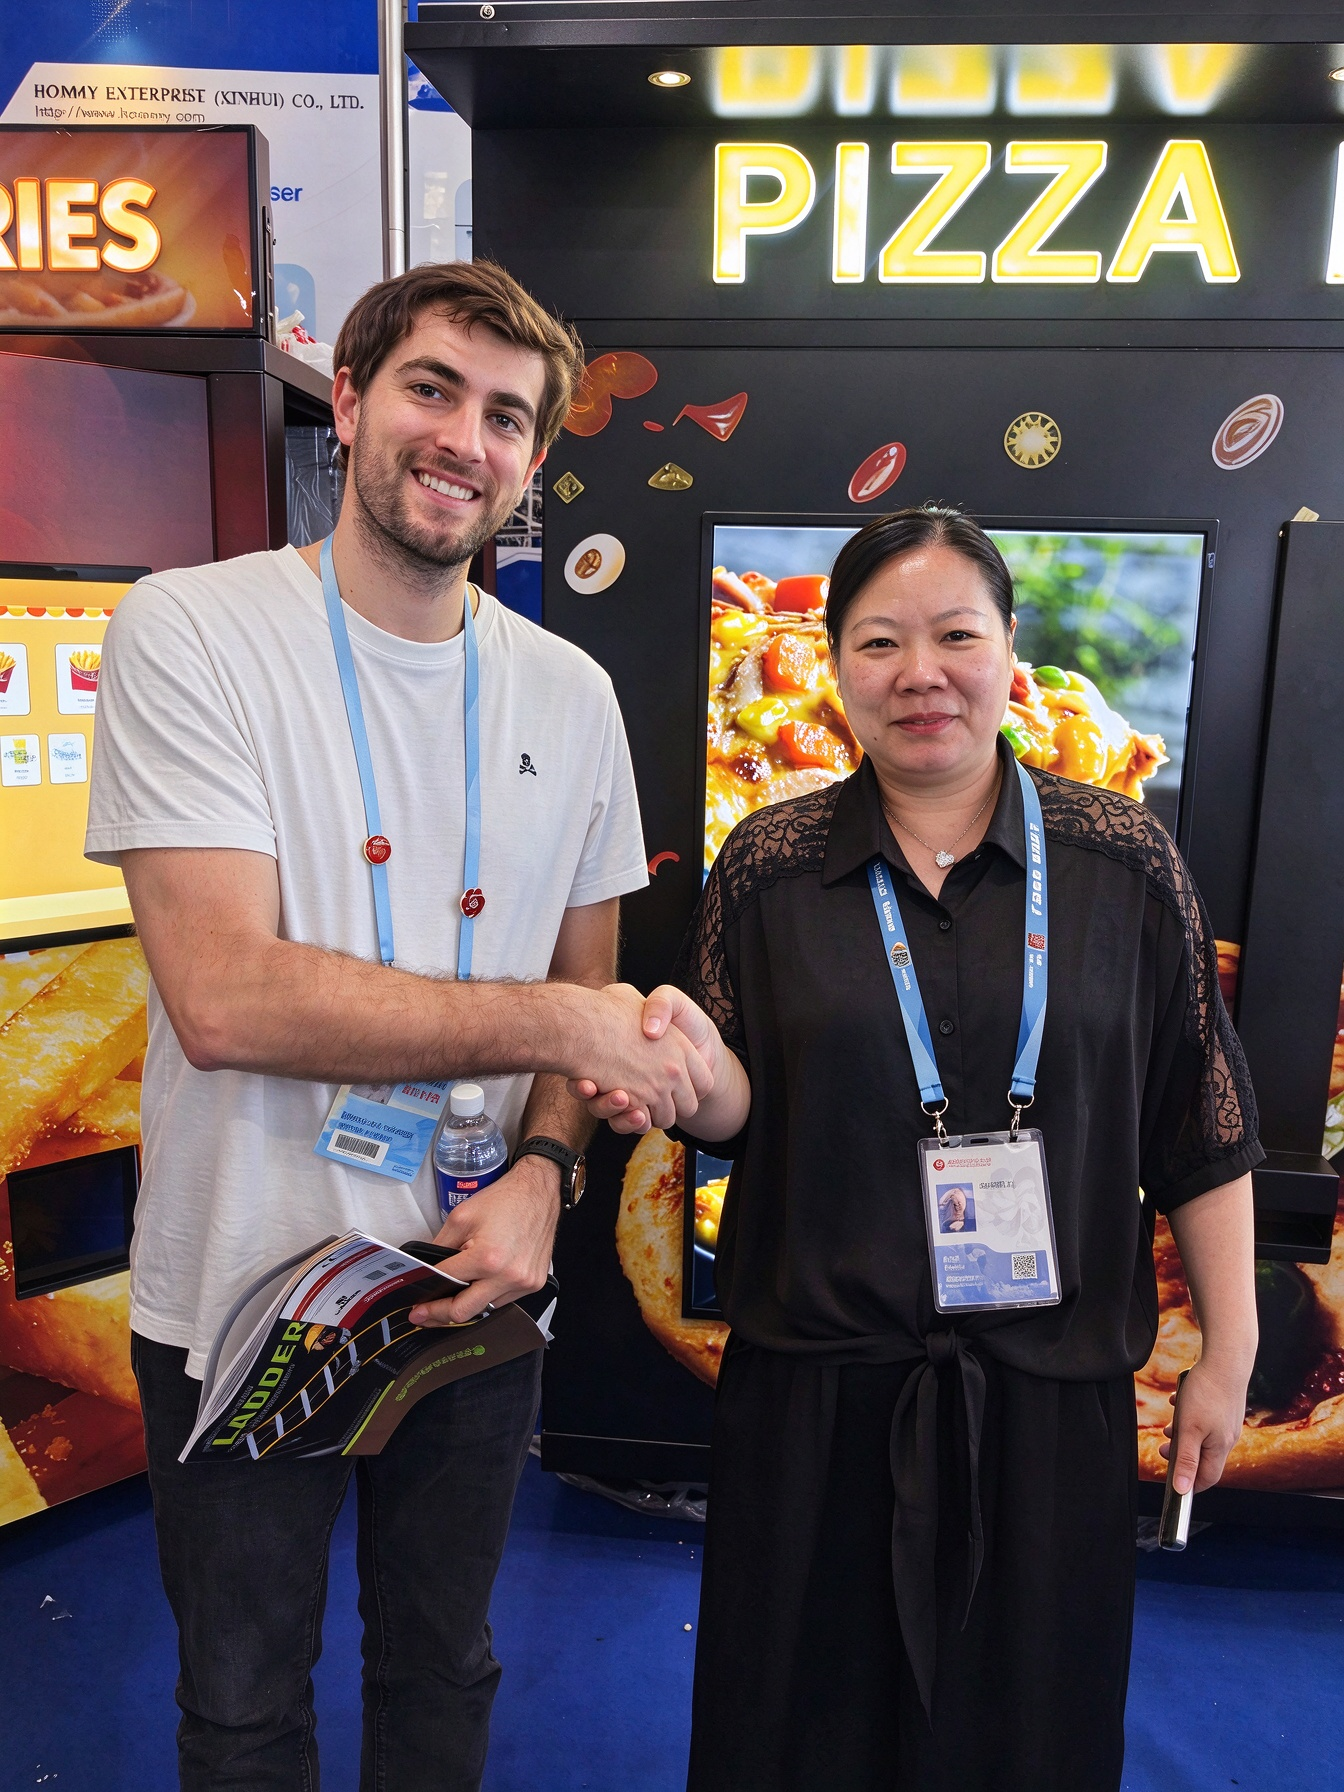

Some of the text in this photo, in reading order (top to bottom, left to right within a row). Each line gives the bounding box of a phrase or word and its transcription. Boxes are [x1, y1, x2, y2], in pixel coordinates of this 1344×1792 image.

[292, 94, 323, 110] CO.,
[330, 95, 364, 110] LTD.
[712, 139, 1241, 284] PIZZA
[211, 1321, 308, 1446] LADDER
